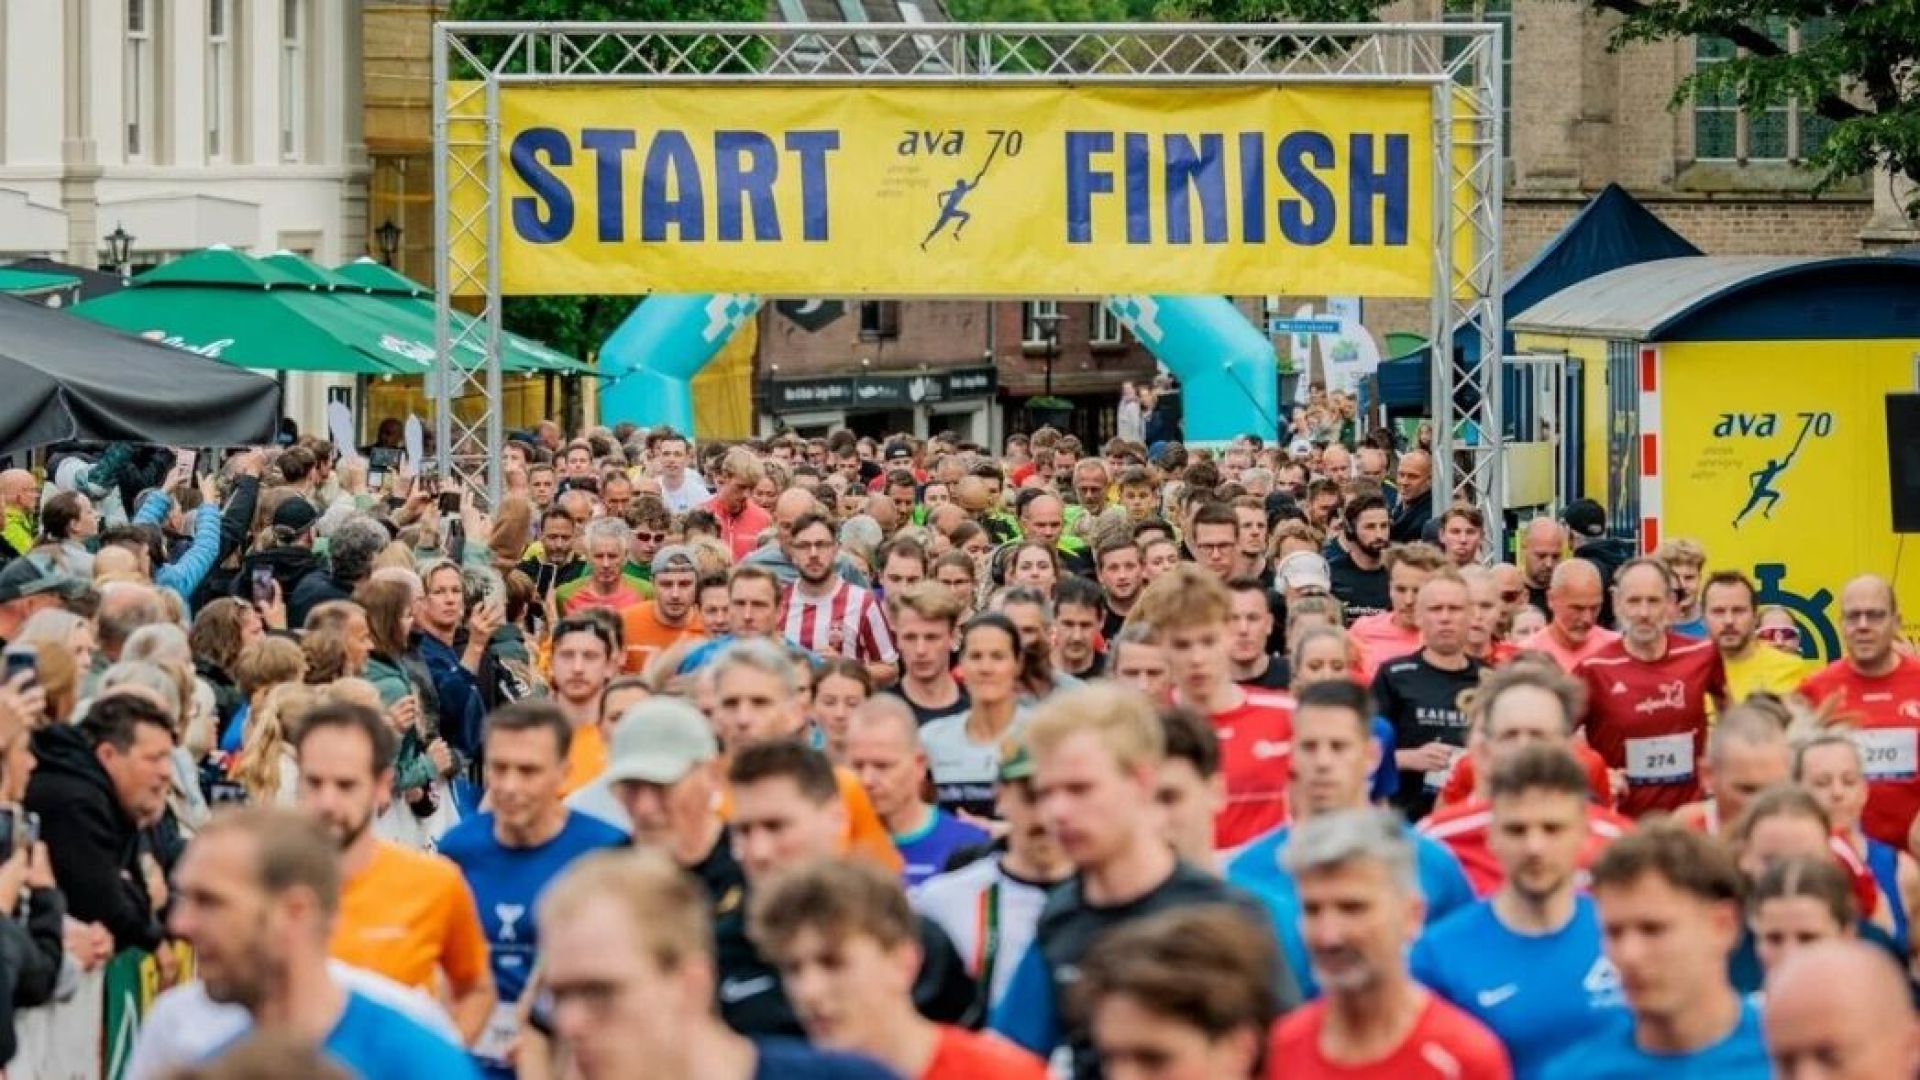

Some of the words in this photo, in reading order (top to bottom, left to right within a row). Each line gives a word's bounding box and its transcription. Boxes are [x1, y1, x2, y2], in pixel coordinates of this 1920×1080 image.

[898, 131, 963, 155] ava
[985, 130, 1023, 161] 70
[509, 126, 840, 245] START
[1065, 130, 1409, 247] FINISH
[1713, 412, 1776, 438] ava
[1797, 411, 1832, 441] 70
[1646, 752, 1676, 768] 274
[1866, 747, 1898, 762] 270
